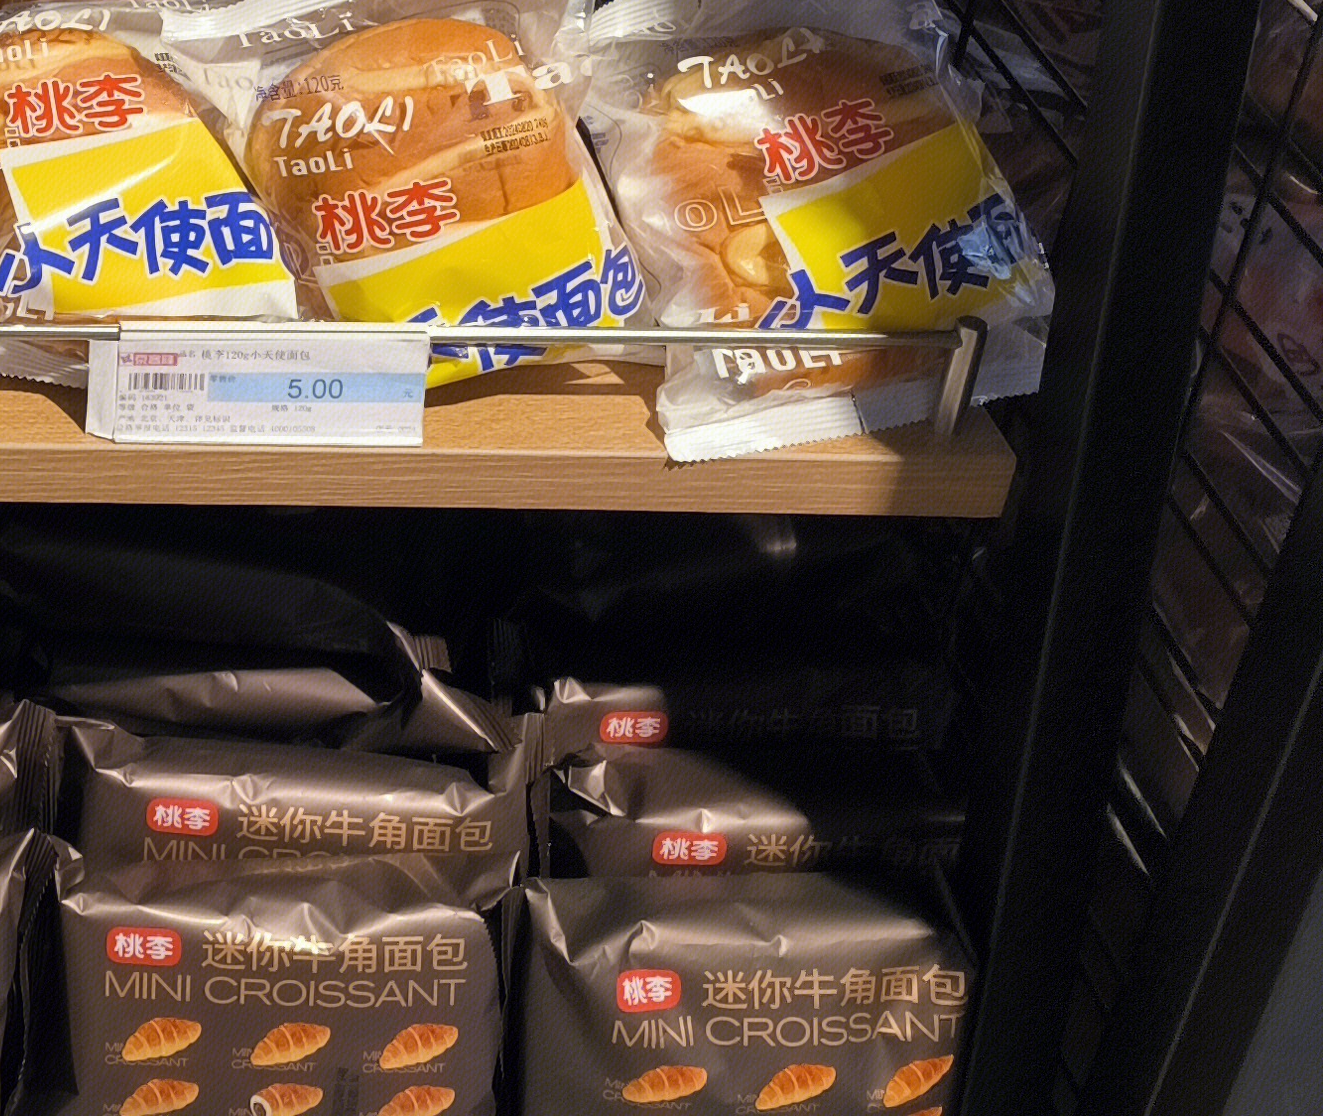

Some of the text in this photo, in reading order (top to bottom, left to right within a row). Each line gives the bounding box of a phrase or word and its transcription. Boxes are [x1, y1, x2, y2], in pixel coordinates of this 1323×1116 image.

[3, 73, 148, 138] 桃李
[753, 97, 895, 184] 桃李
[273, 147, 355, 178] TaoLi
[313, 178, 460, 254] 桃李
[287, 378, 344, 399] 5.00
[605, 716, 663, 739] 桃李
[152, 804, 494, 854] 桃李 迷你牛角面包
[659, 837, 721, 861] 桃李
[113, 930, 469, 976] 桃李 迷你牛角面包
[104, 970, 468, 1009] MINI CROISSANT
[621, 963, 969, 1012] 桃李 迷你牛角面包
[611, 1010, 964, 1051] MINI CROISSANT
